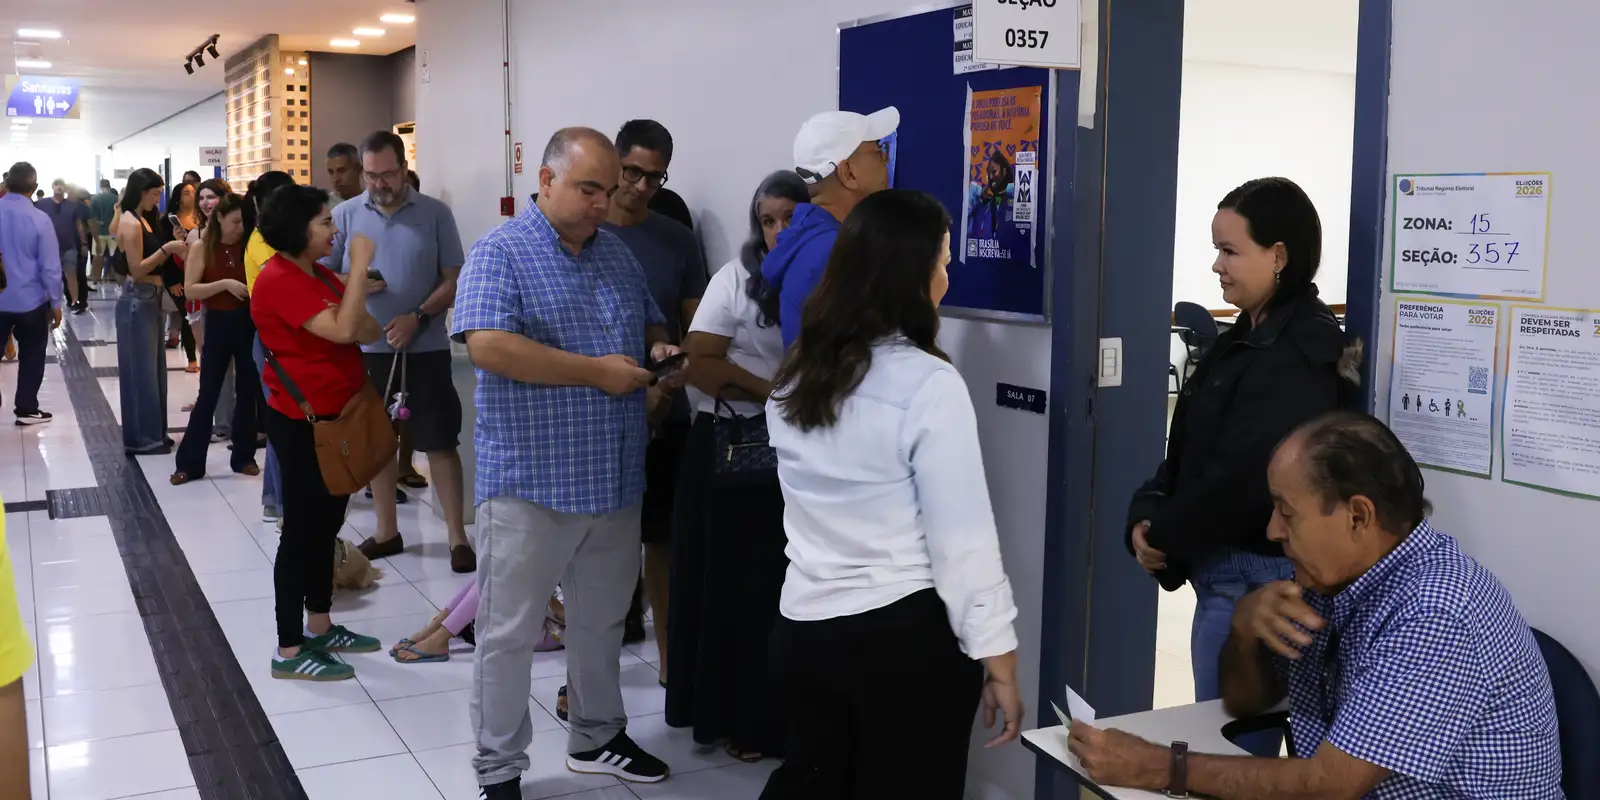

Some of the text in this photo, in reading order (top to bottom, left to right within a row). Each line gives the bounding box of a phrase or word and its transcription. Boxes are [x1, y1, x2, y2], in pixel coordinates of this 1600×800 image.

[956, 21, 973, 30] EDUCA
[1005, 28, 1049, 49] 0357
[956, 54, 973, 62] EDUCA
[1515, 186, 1543, 195] 2026
[1403, 213, 1491, 235] ZONA: 15
[979, 239, 999, 248] BRASÍLIA
[1402, 242, 1520, 266] SEÇÃO: 357
[1400, 304, 1444, 313] PREFERÊNCIA
[1400, 311, 1444, 320] PARA VOTAR
[1468, 315, 1494, 325] 2026
[1520, 317, 1570, 328] DEVEM SER
[1520, 325, 1581, 338] RESPEITADAS
[1007, 390, 1035, 402] SALA 07
